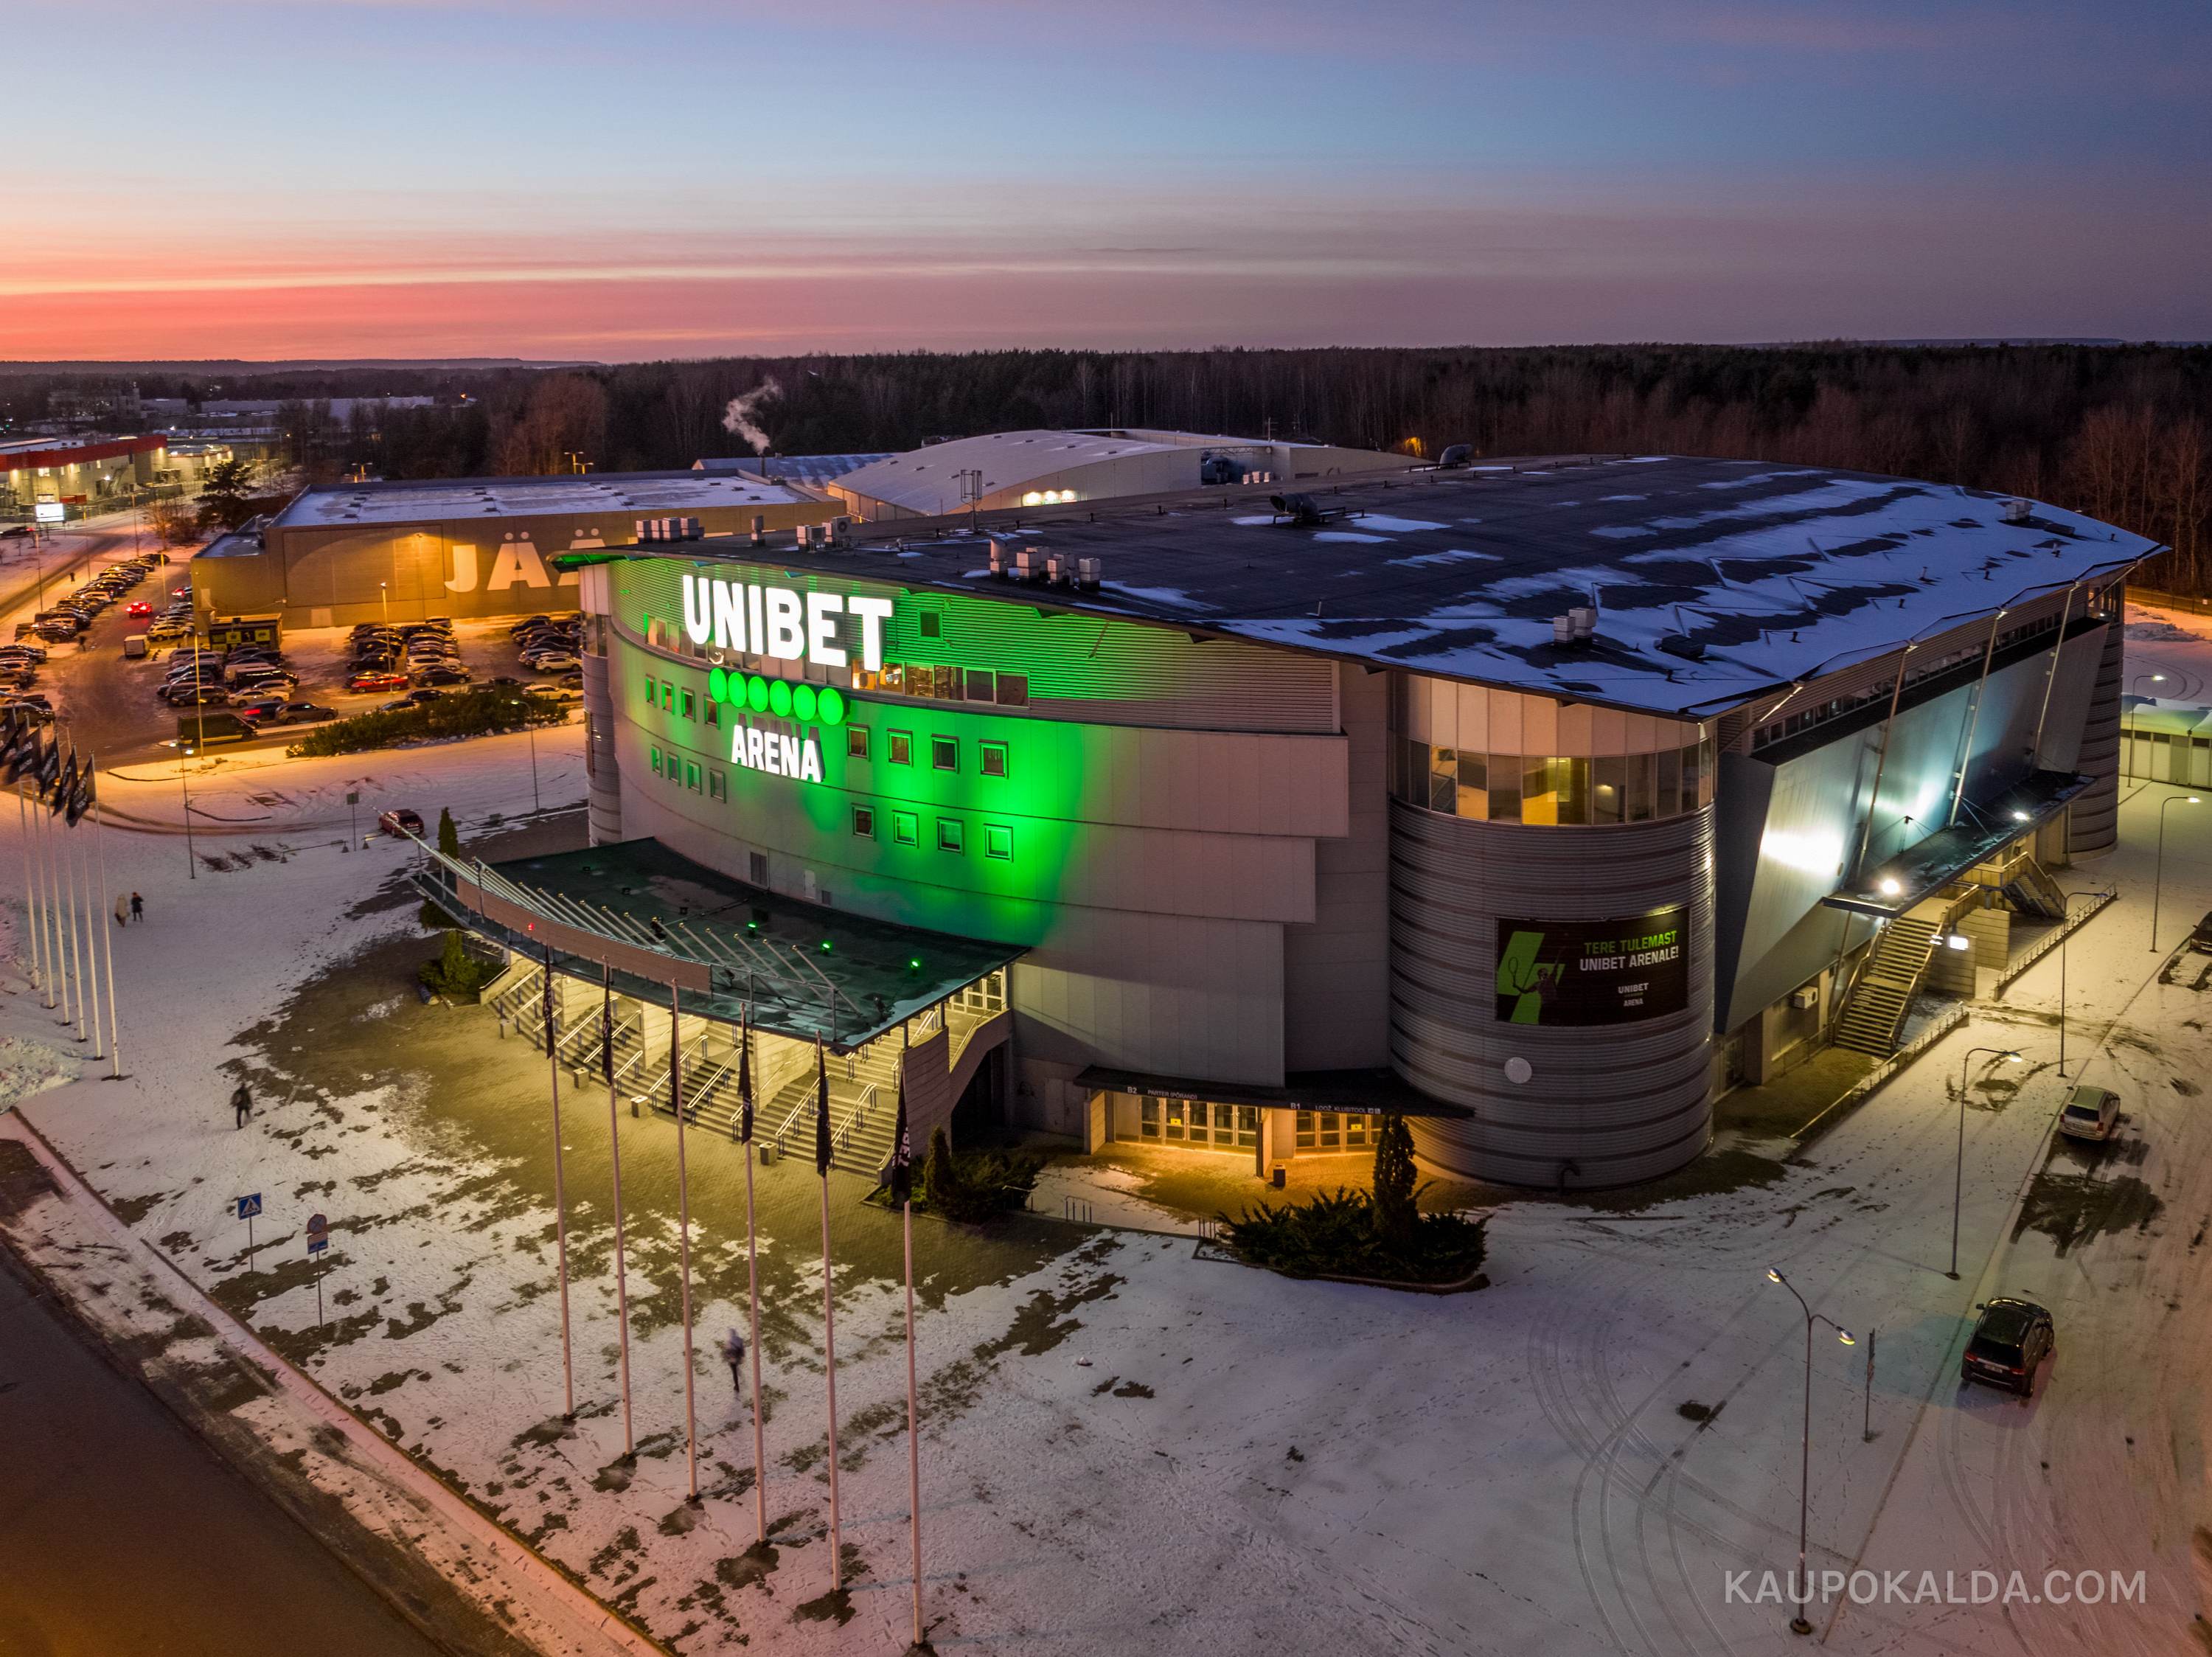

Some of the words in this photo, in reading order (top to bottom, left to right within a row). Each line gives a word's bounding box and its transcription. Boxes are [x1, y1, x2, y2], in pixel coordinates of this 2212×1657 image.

[682, 574, 893, 672] UNIBET
[731, 724, 822, 783] ARENA
[1584, 941, 1616, 955] TERE
[1620, 930, 1677, 952] TULEMAST
[1579, 956, 1626, 971] UNIBET
[1629, 945, 1680, 968] ARENALE!
[1618, 982, 1649, 994] UNIBET
[1623, 998, 1644, 1007] ARENA
[1127, 1086, 1138, 1094] B2
